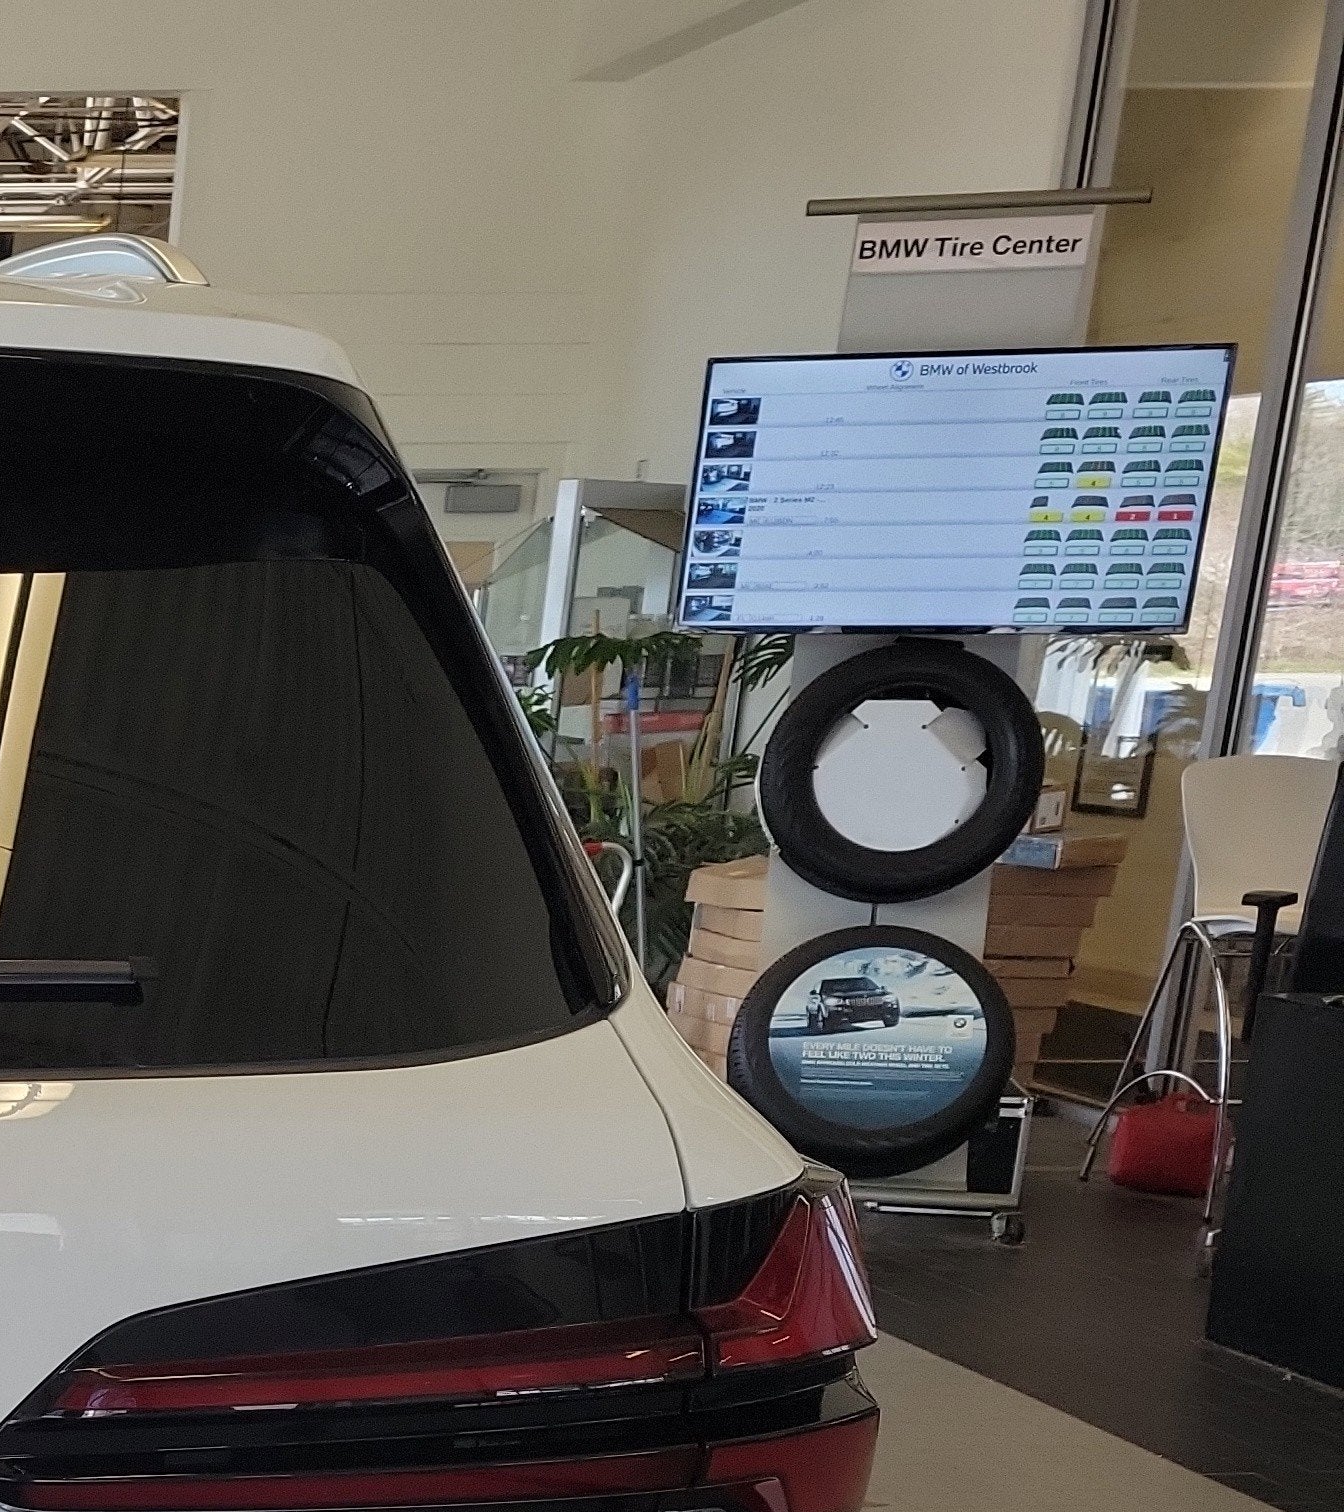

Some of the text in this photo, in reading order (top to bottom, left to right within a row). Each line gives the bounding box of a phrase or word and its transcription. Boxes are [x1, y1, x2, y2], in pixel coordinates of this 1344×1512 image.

[858, 234, 1083, 260] BMW Tire Center
[920, 361, 1039, 376] BMW of Westbrook
[803, 1041, 834, 1051] EVERY
[837, 1042, 861, 1051] MILE
[908, 1045, 936, 1053] HAVE
[938, 1045, 953, 1054] TO
[802, 1050, 827, 1059] FEEL
[828, 1051, 851, 1060] LIKE
[853, 1052, 876, 1061] TWO
[879, 1052, 902, 1061] THIS
